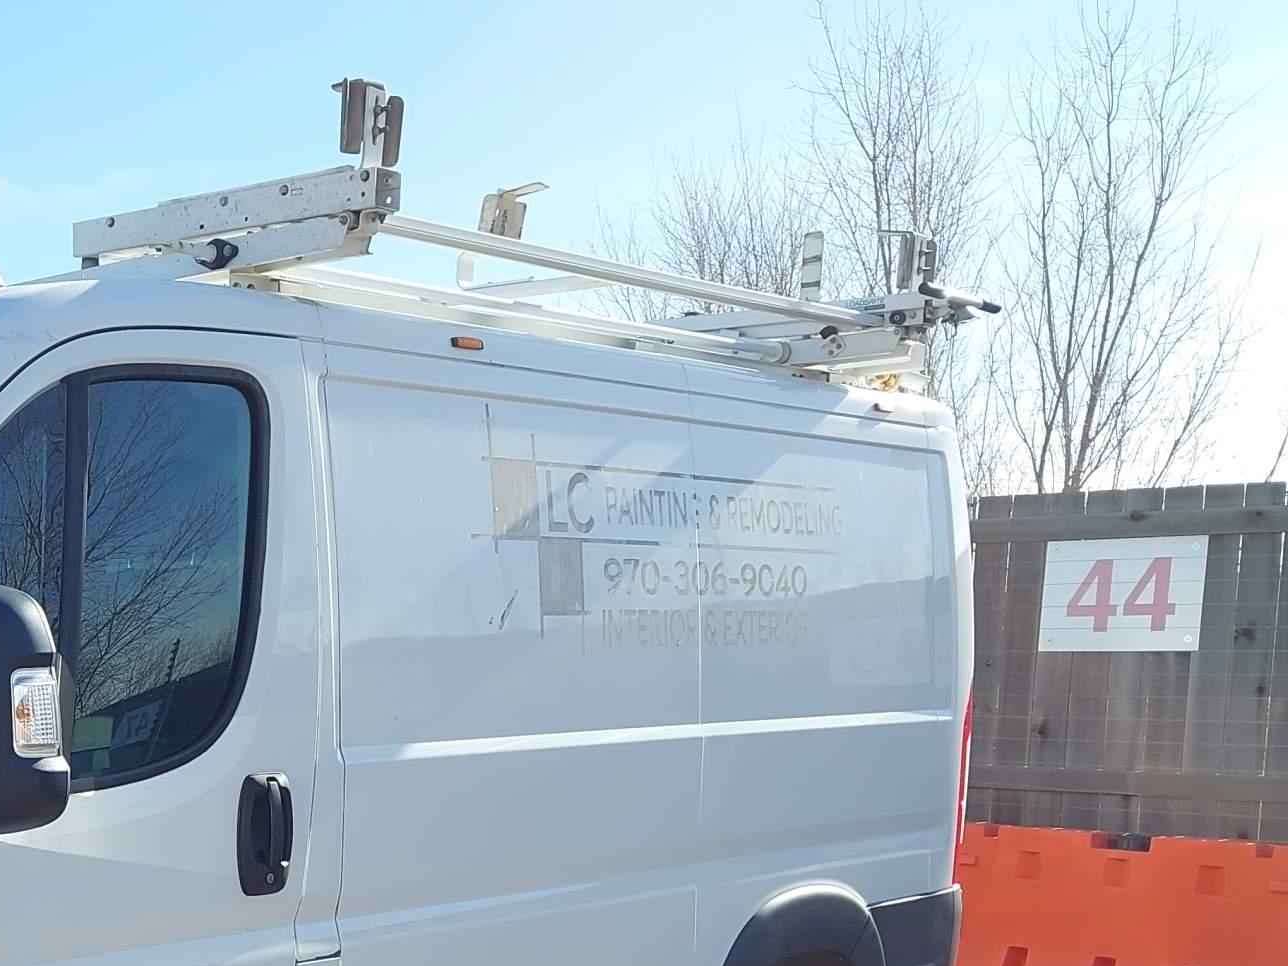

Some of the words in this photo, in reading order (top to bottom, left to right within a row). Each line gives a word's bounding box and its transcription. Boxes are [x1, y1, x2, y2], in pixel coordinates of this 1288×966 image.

[545, 470, 595, 534] LC
[709, 493, 722, 532] &
[727, 497, 843, 537] REMODELING
[603, 557, 808, 599] 970-306-9040
[1066, 556, 1177, 632] 44
[601, 608, 697, 648] INTERIOR
